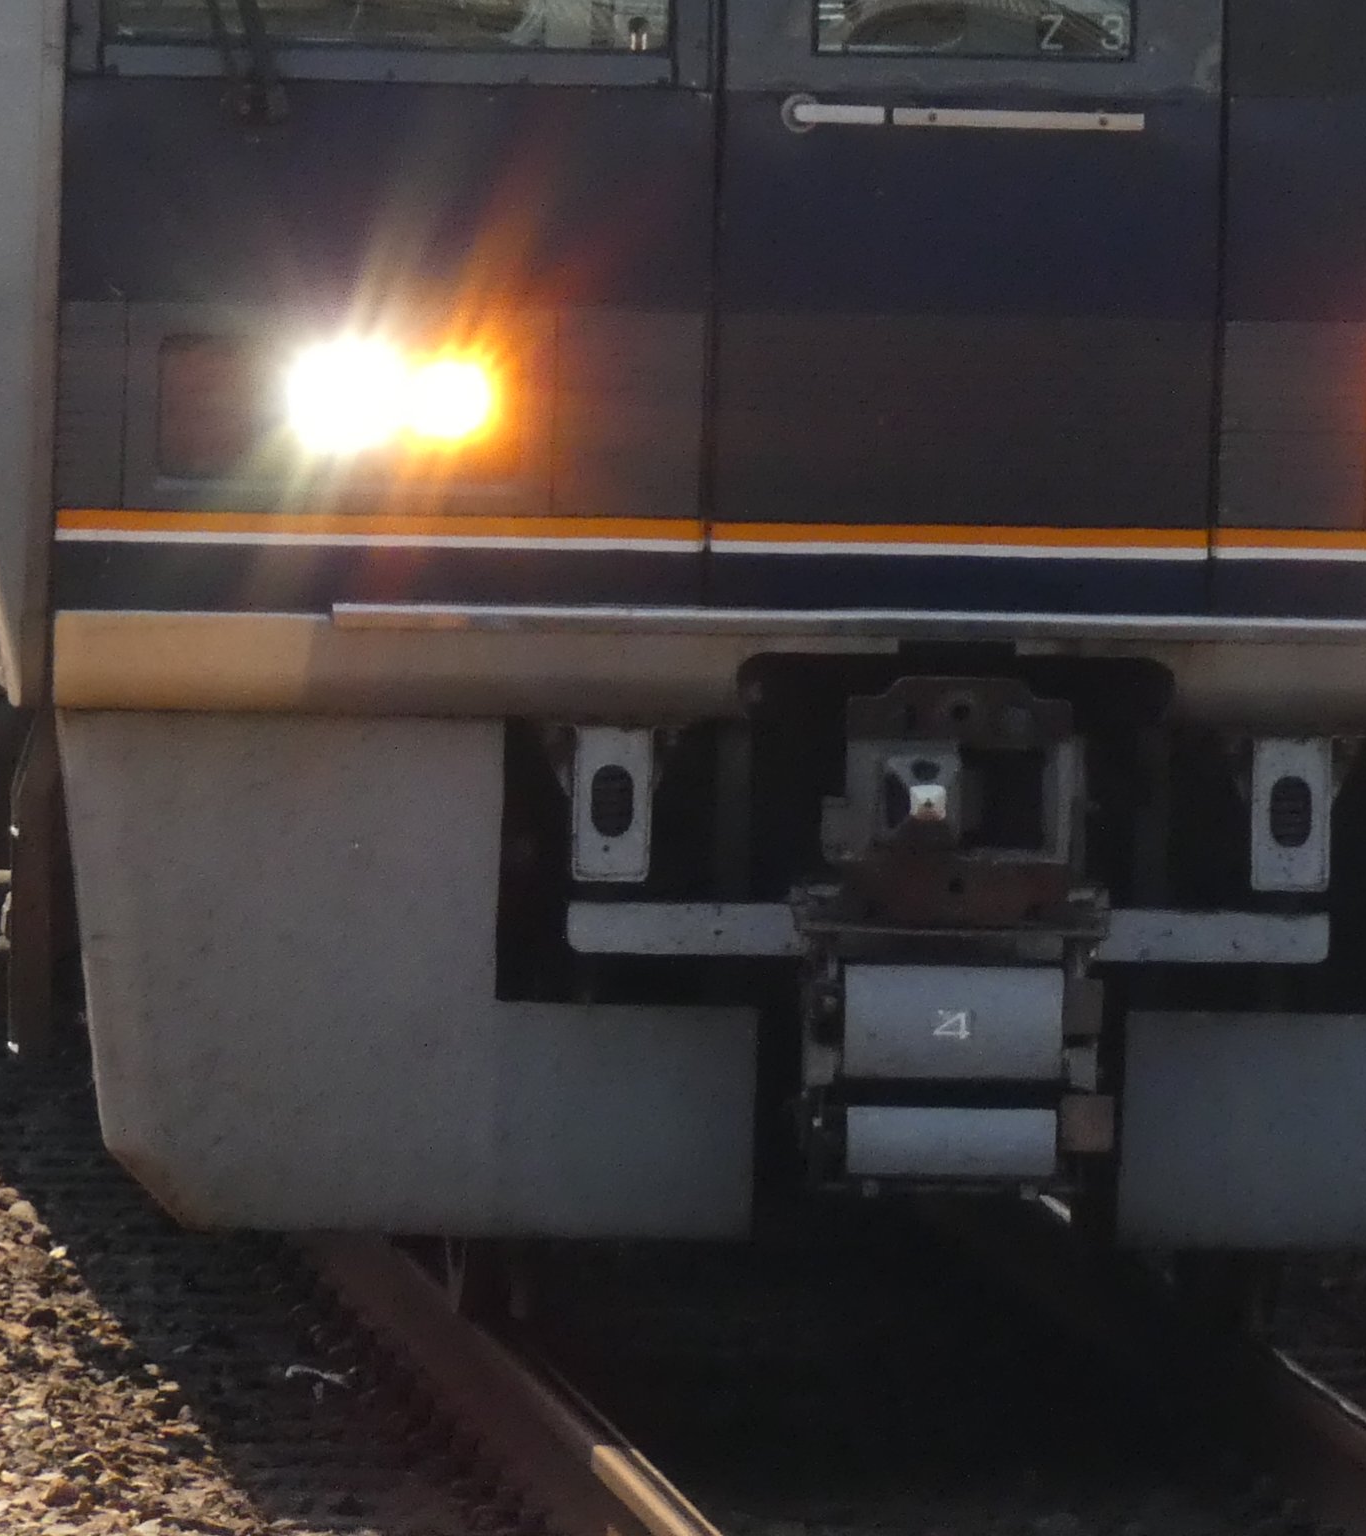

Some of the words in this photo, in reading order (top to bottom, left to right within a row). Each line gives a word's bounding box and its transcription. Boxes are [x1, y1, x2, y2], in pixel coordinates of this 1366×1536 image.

[1040, 14, 1064, 50] Z
[1101, 15, 1124, 50] 3
[934, 1011, 970, 1039] 4
